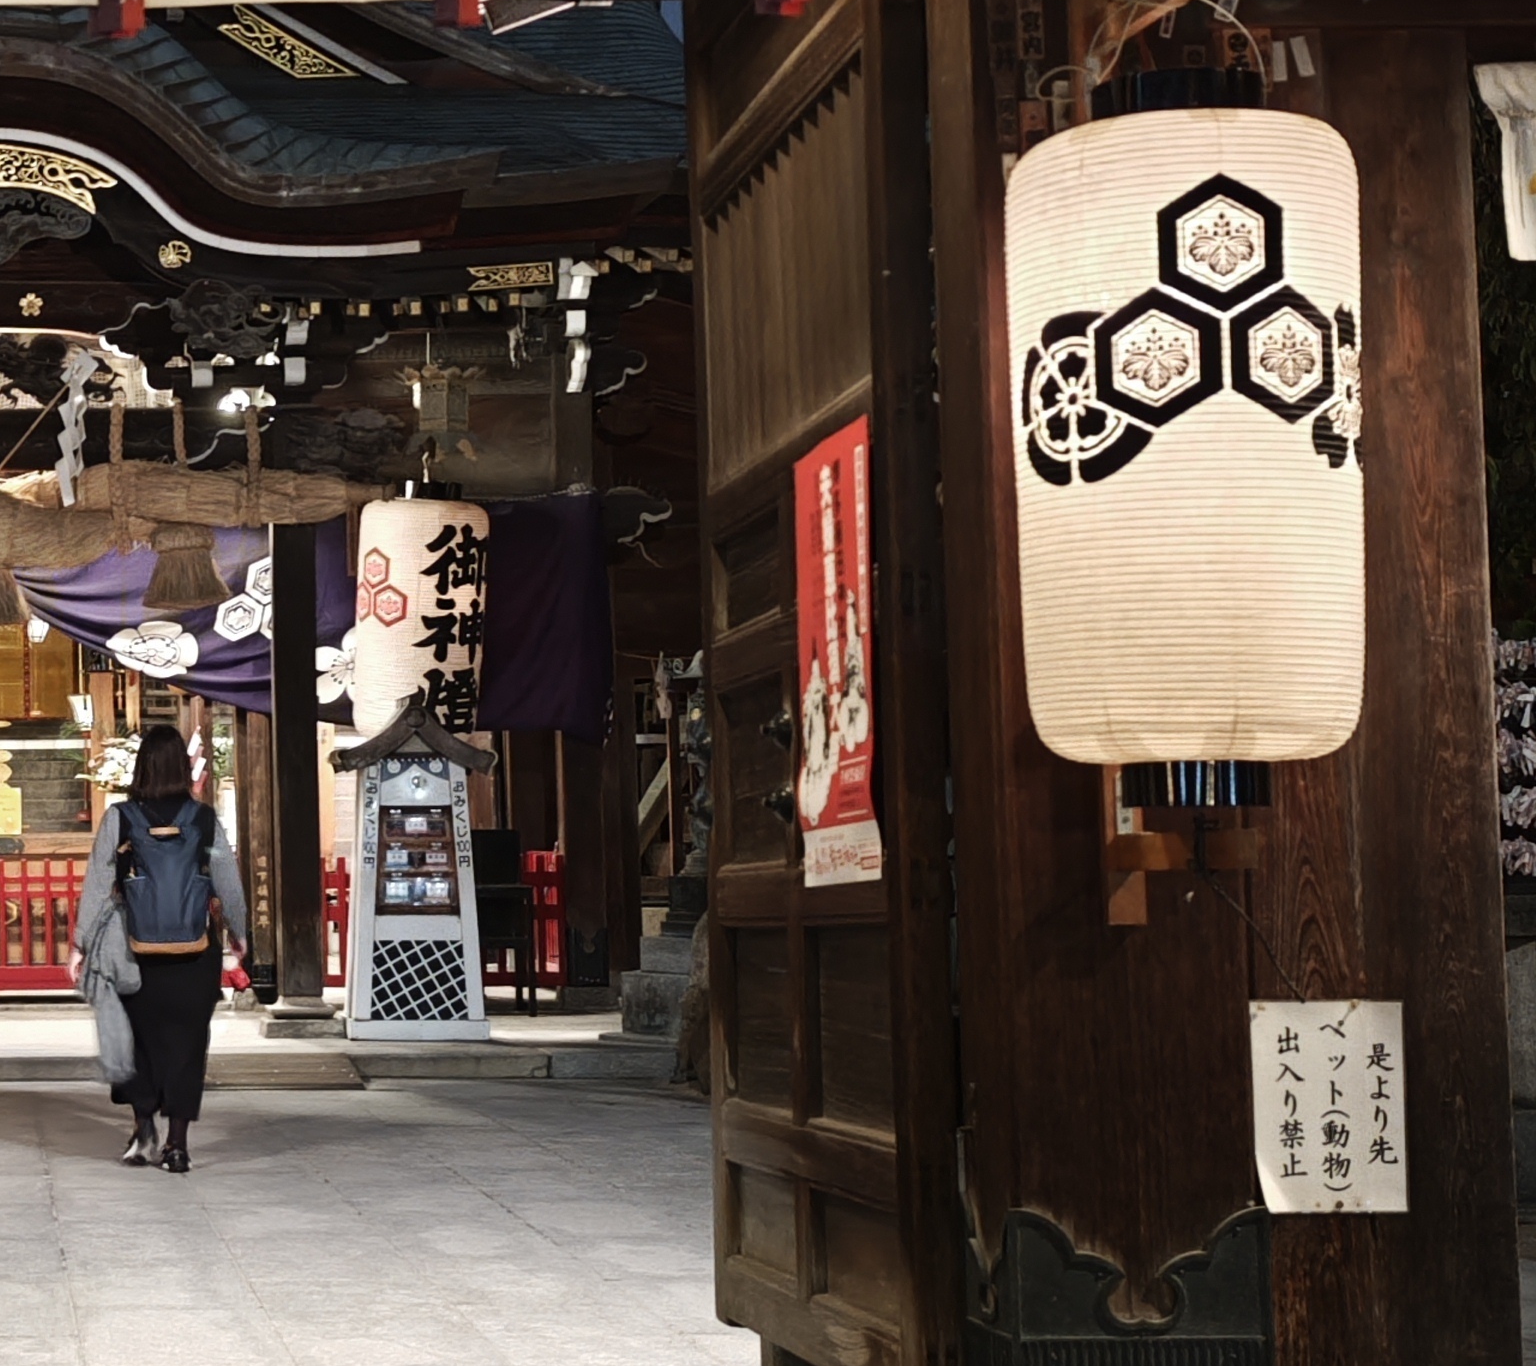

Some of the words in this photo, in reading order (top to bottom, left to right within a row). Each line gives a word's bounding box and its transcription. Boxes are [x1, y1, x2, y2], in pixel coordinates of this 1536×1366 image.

[1276, 1026, 1309, 1179] 出入り禁止
[1366, 1042, 1399, 1165] 是より先
